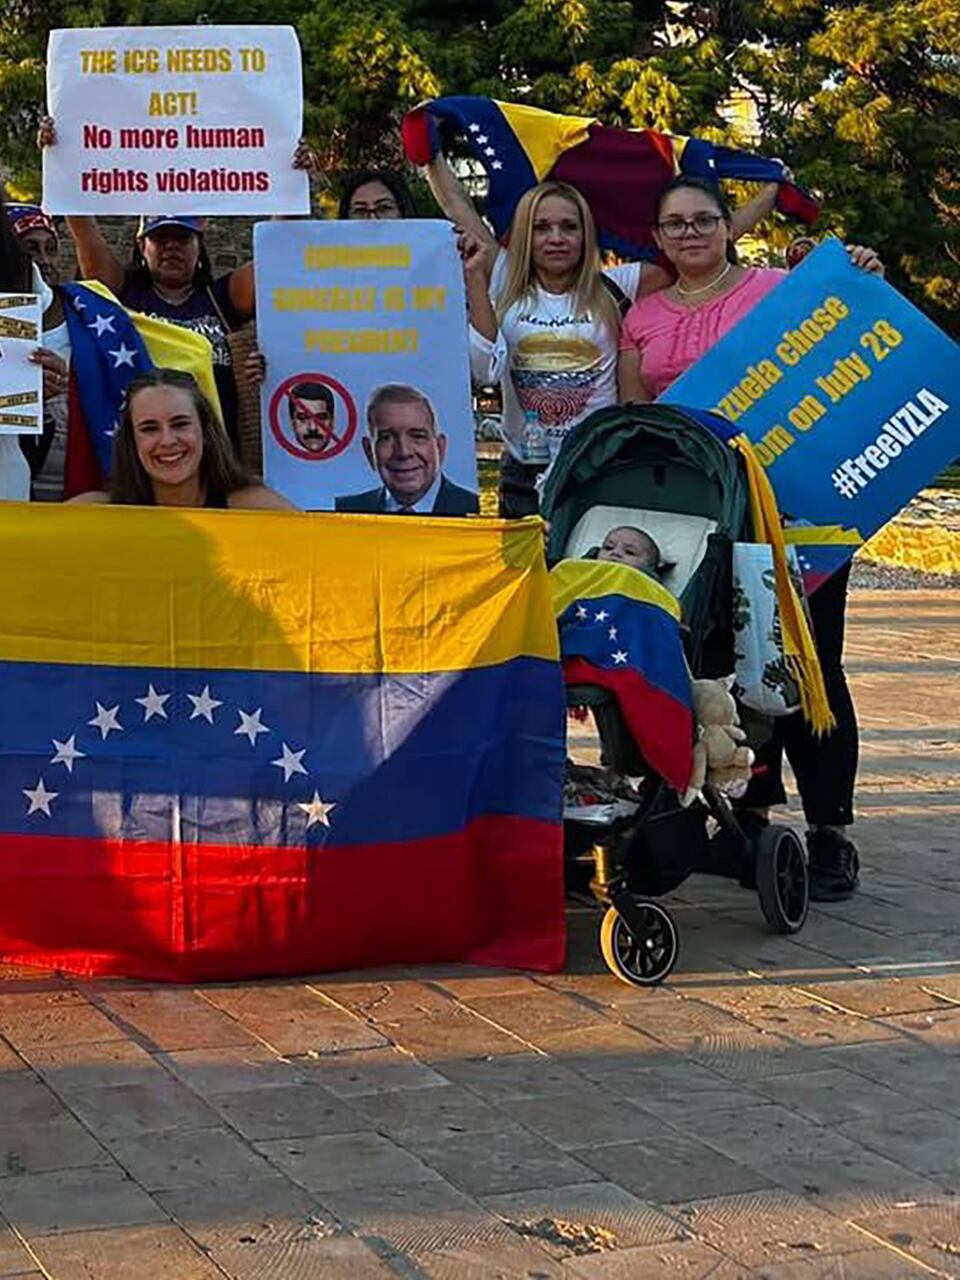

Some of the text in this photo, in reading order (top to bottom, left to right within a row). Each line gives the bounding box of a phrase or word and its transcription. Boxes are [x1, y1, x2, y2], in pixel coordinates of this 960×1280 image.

[80, 48, 266, 73] THE ICC NEEDS TO
[148, 91, 198, 116] ACT!
[83, 125, 265, 149] No more human
[81, 168, 270, 194] rights violations
[712, 296, 849, 422] zuela chose
[787, 393, 828, 432] on
[815, 352, 872, 404] July
[860, 319, 904, 362] 28
[830, 387, 950, 500] #FreeVZLA
